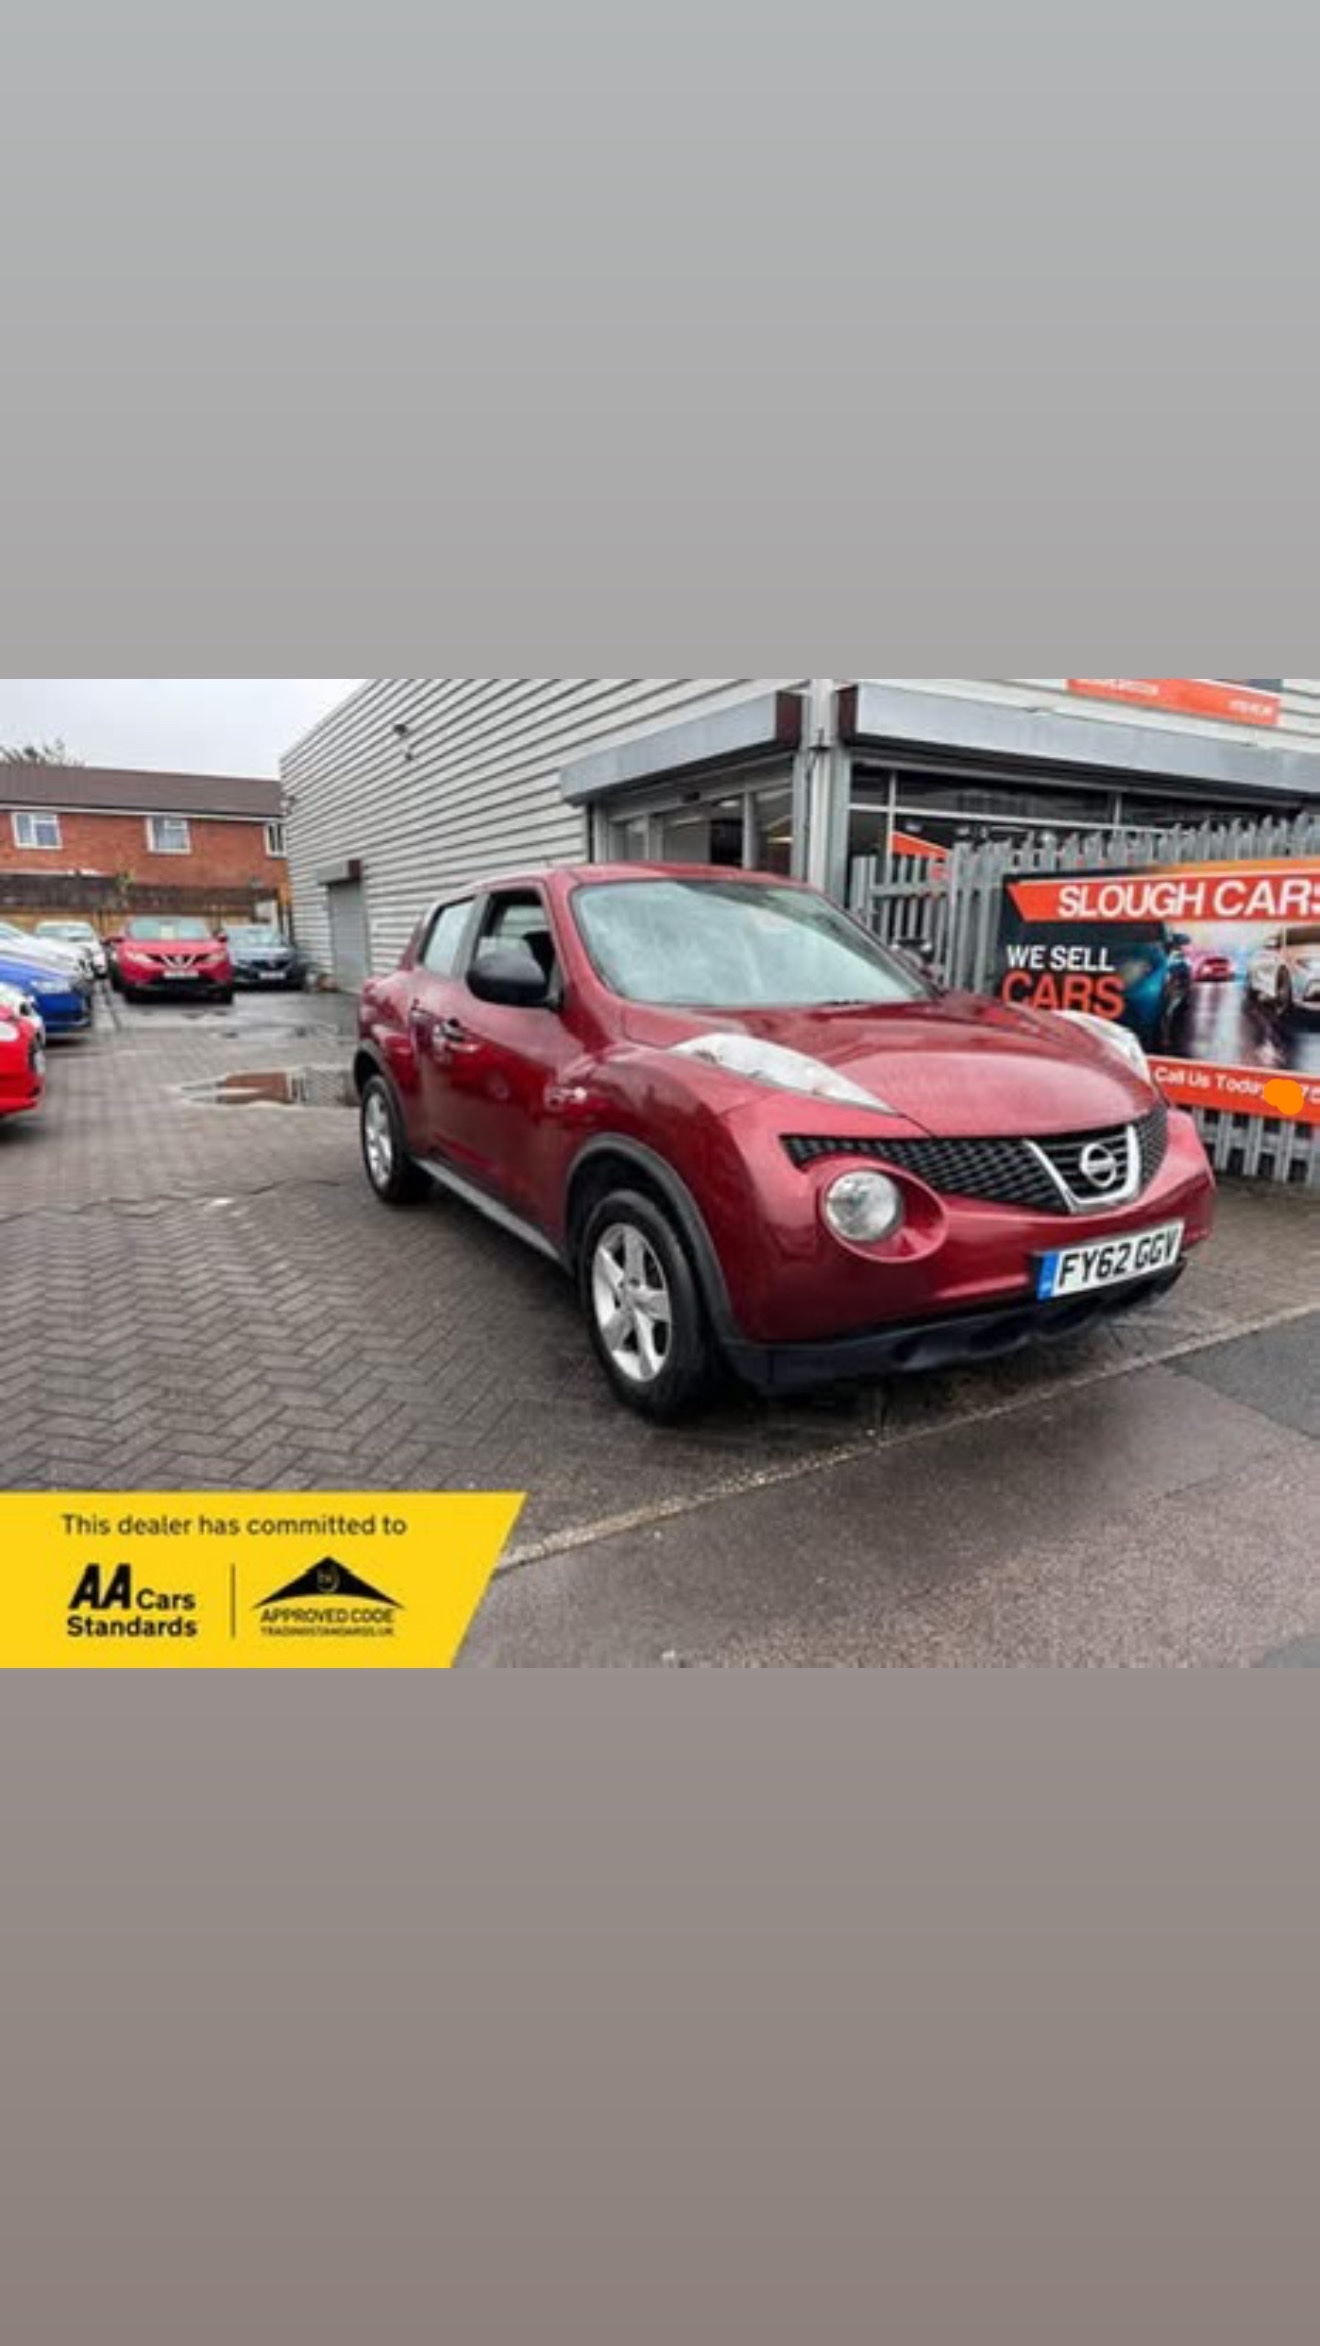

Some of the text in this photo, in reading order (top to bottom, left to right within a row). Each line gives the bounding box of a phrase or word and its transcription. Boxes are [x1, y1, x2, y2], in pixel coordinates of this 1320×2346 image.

[1058, 881, 1206, 918] SLOUGH
[1006, 944, 1115, 972] WE SELL
[1002, 970, 1126, 1019] CARS
[1155, 1066, 1185, 1085] Call
[1189, 1070, 1210, 1088] Us
[1058, 1226, 1180, 1288] FY62 GGV
